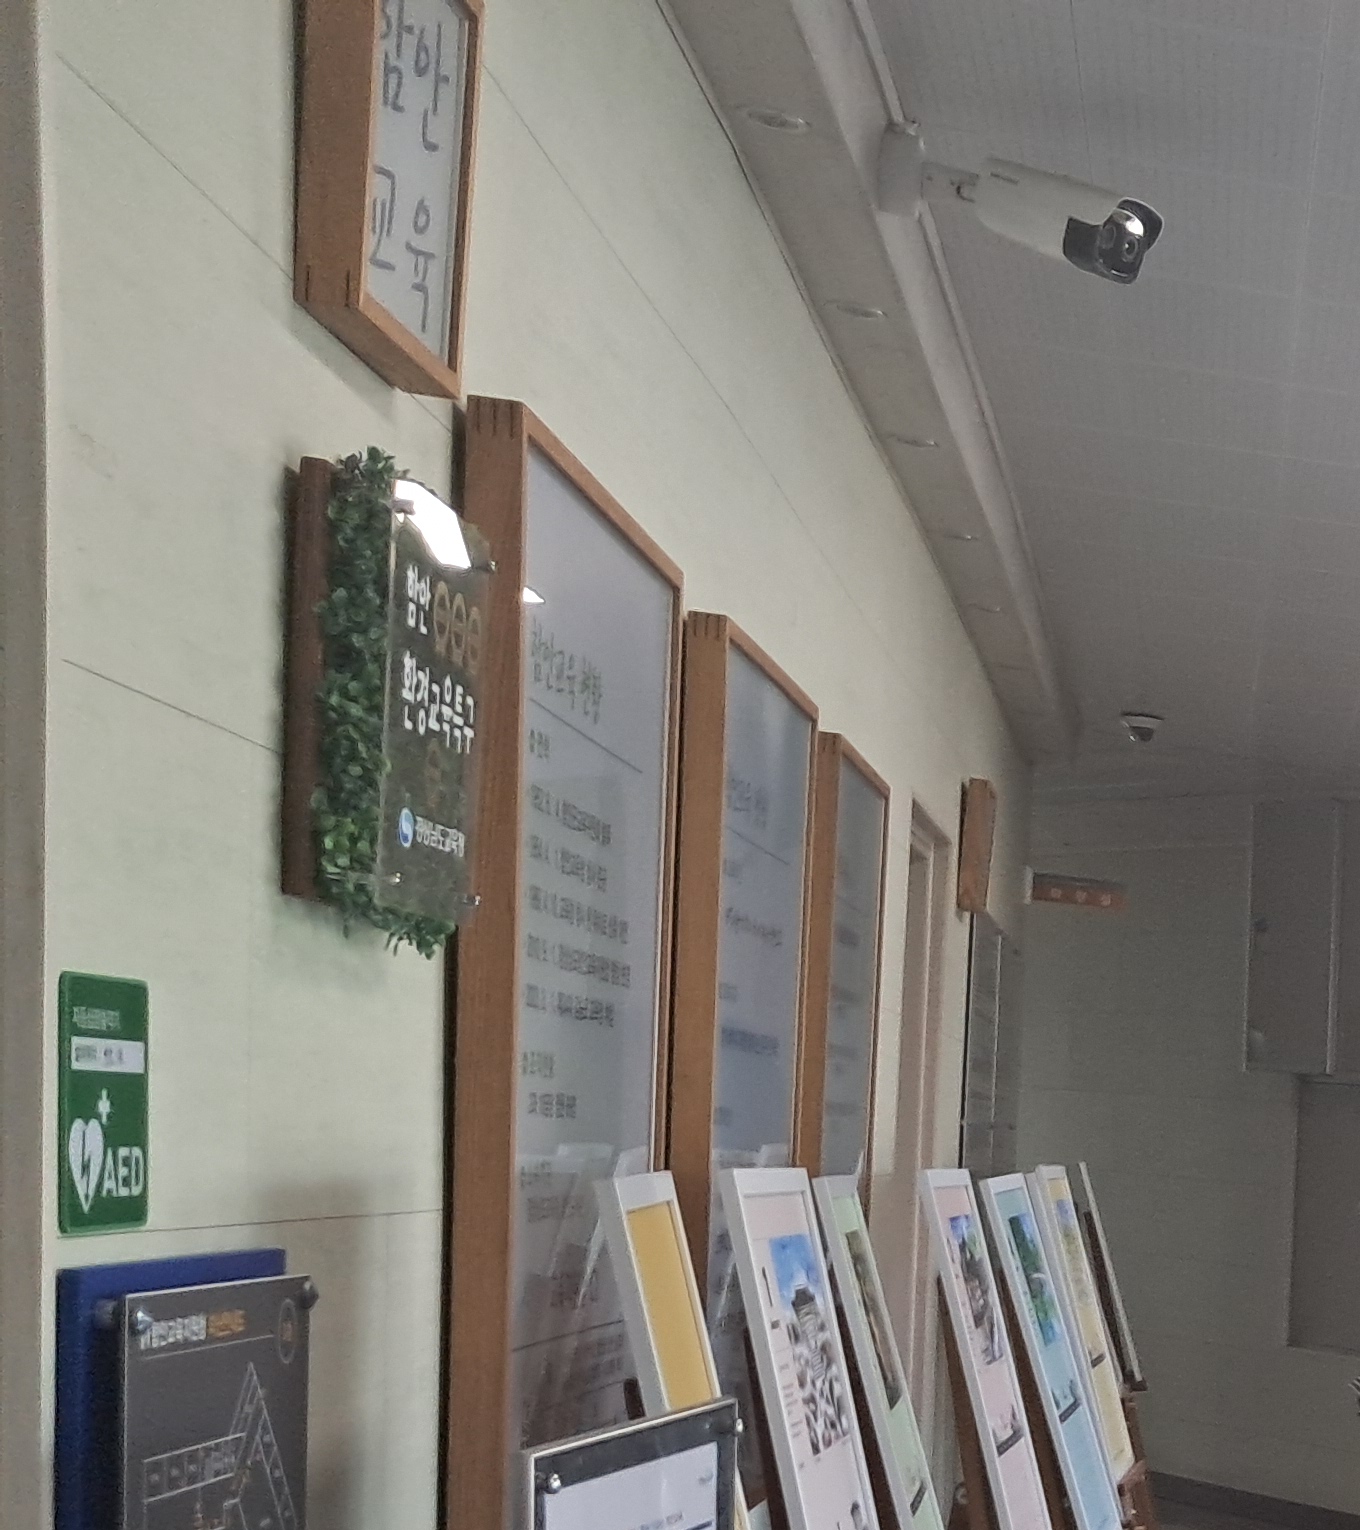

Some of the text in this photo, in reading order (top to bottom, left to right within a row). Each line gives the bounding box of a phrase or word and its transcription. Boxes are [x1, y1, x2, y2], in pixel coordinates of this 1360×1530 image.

[369, 164, 437, 334] 교육
[407, 564, 432, 636] 함안
[402, 650, 475, 754] 환경교육특구
[102, 1146, 145, 1198] AED
